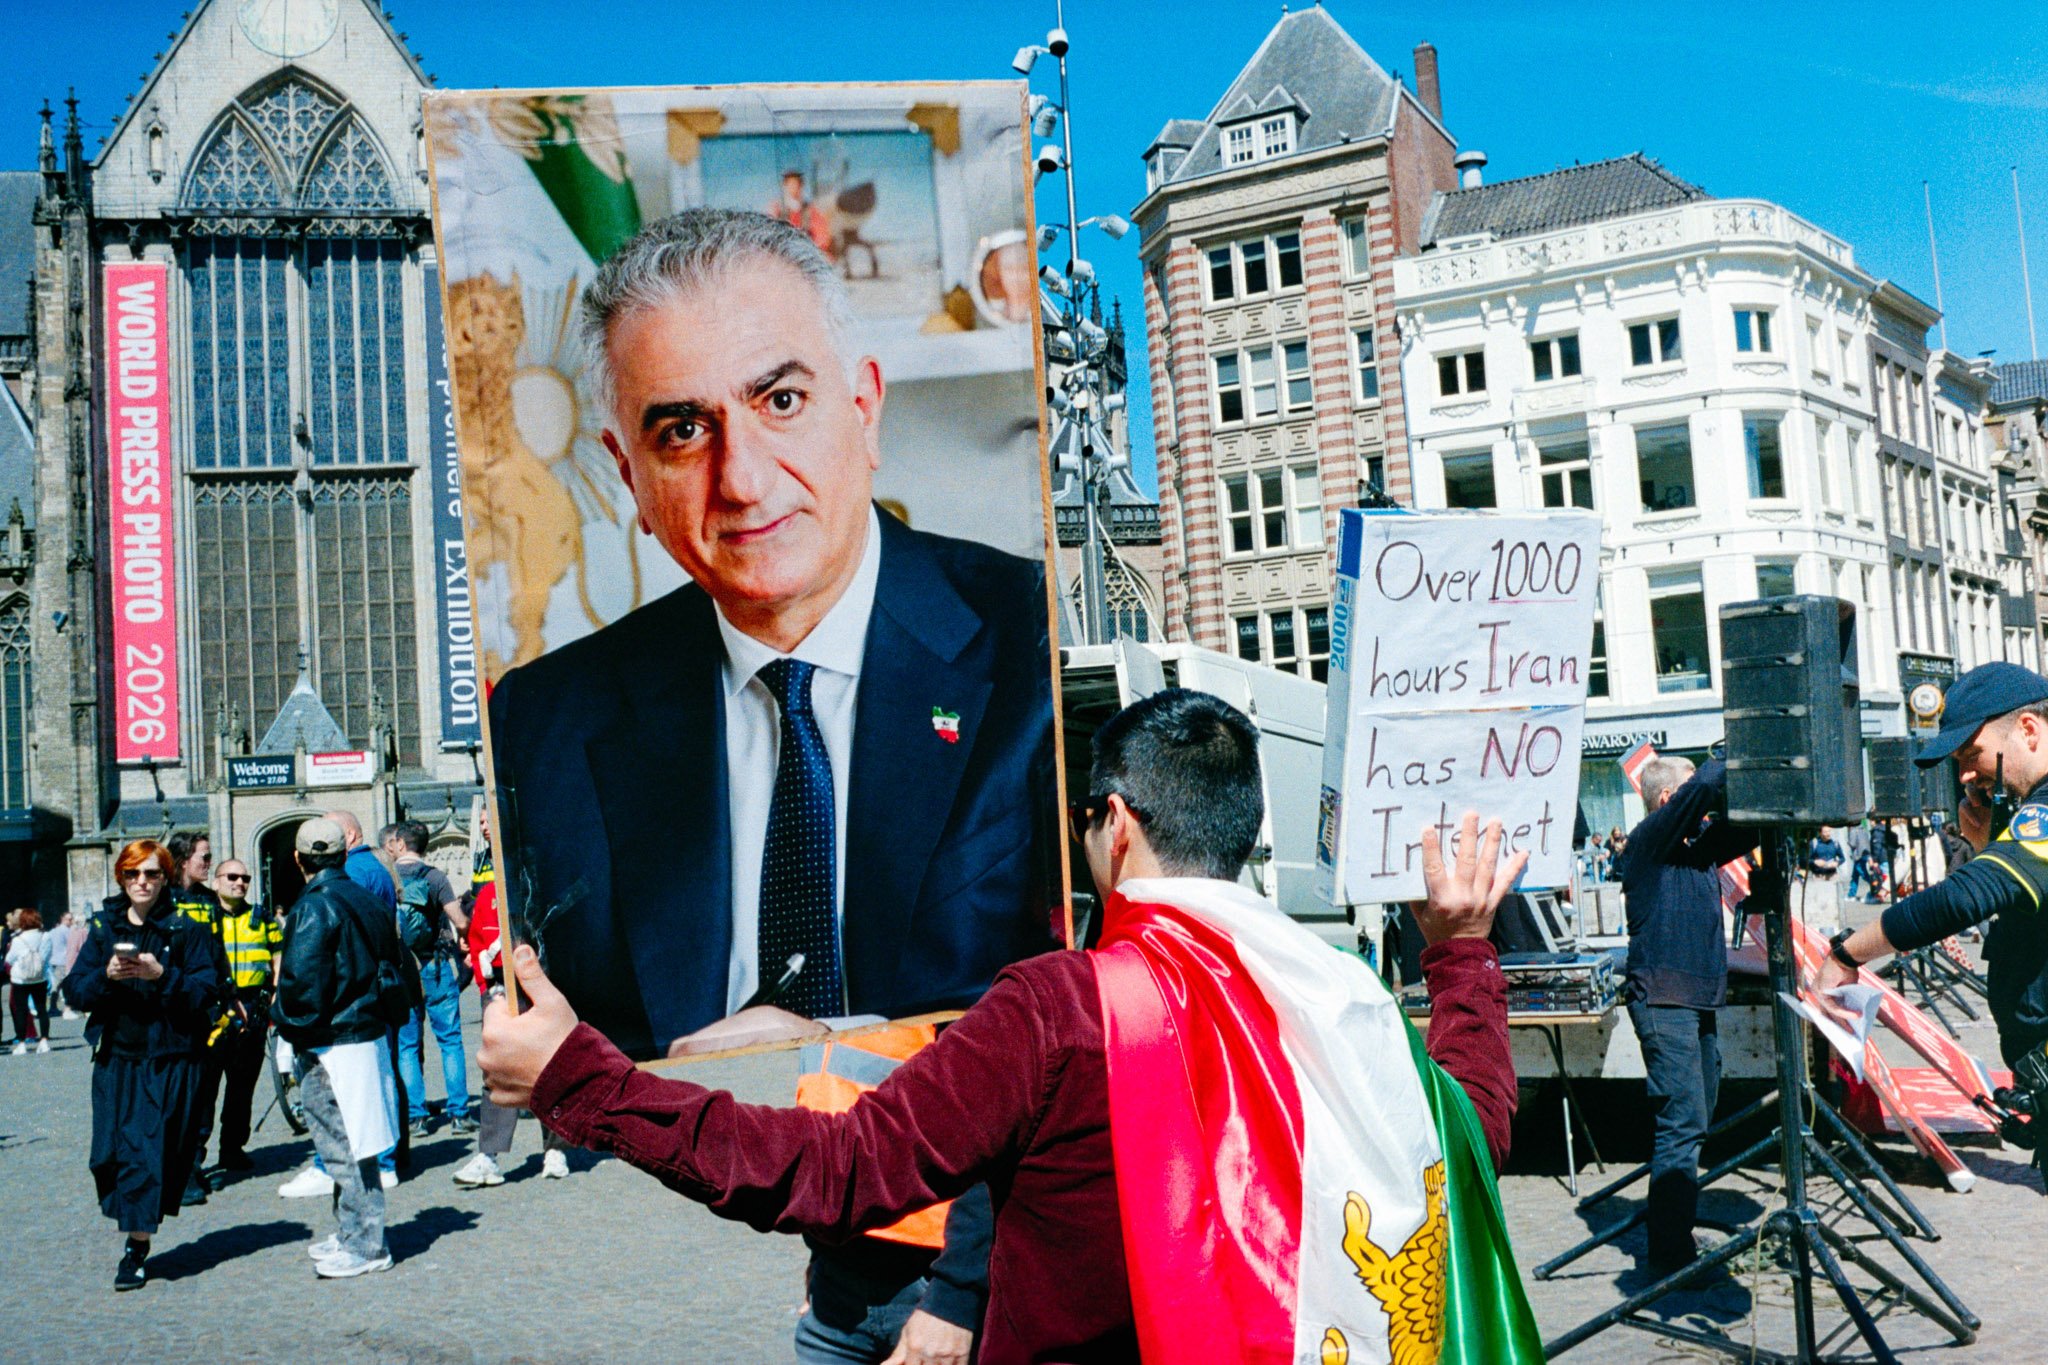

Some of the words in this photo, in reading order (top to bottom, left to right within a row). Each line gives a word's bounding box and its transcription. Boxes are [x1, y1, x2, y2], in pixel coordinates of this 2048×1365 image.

[117, 281, 157, 399] WORLD
[120, 406, 160, 506] PRESS
[123, 513, 164, 623] PHOTO
[1375, 541, 1480, 602] Over
[1488, 539, 1582, 601] 1000
[1330, 604, 1348, 671] 2000
[1370, 636, 1469, 698] hours
[1478, 621, 1579, 697] Iran
[126, 643, 167, 744] 2026
[233, 762, 290, 776] Welcome
[1366, 727, 1456, 789] has
[1480, 722, 1562, 781] NO
